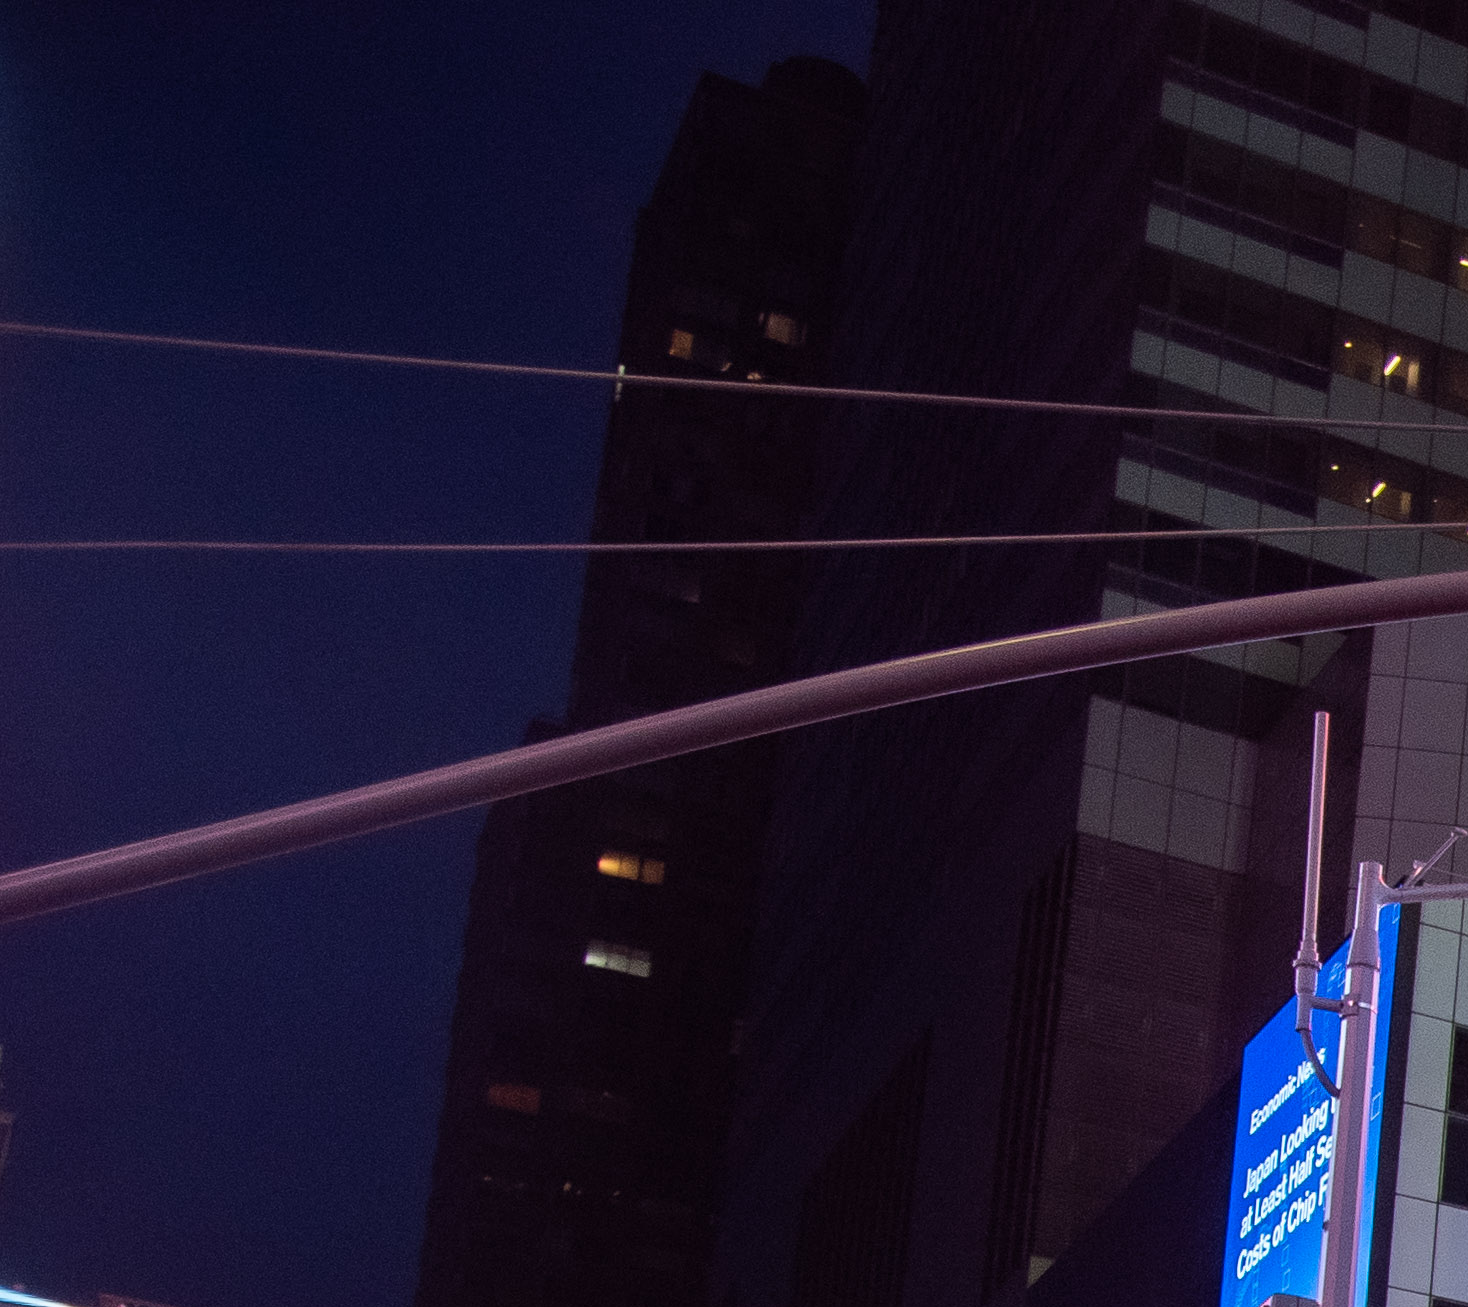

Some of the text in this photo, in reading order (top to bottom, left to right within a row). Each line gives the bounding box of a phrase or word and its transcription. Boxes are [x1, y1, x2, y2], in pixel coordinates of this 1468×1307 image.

[1250, 1074, 1296, 1134] Economic
[1240, 1135, 1334, 1239] at Least Half Se
[1243, 1149, 1278, 1198] Japan
[1280, 1105, 1329, 1163] Looking
[1237, 1231, 1270, 1279] Costs
[1272, 1212, 1288, 1247] of
[1288, 1189, 1316, 1233] Chip
